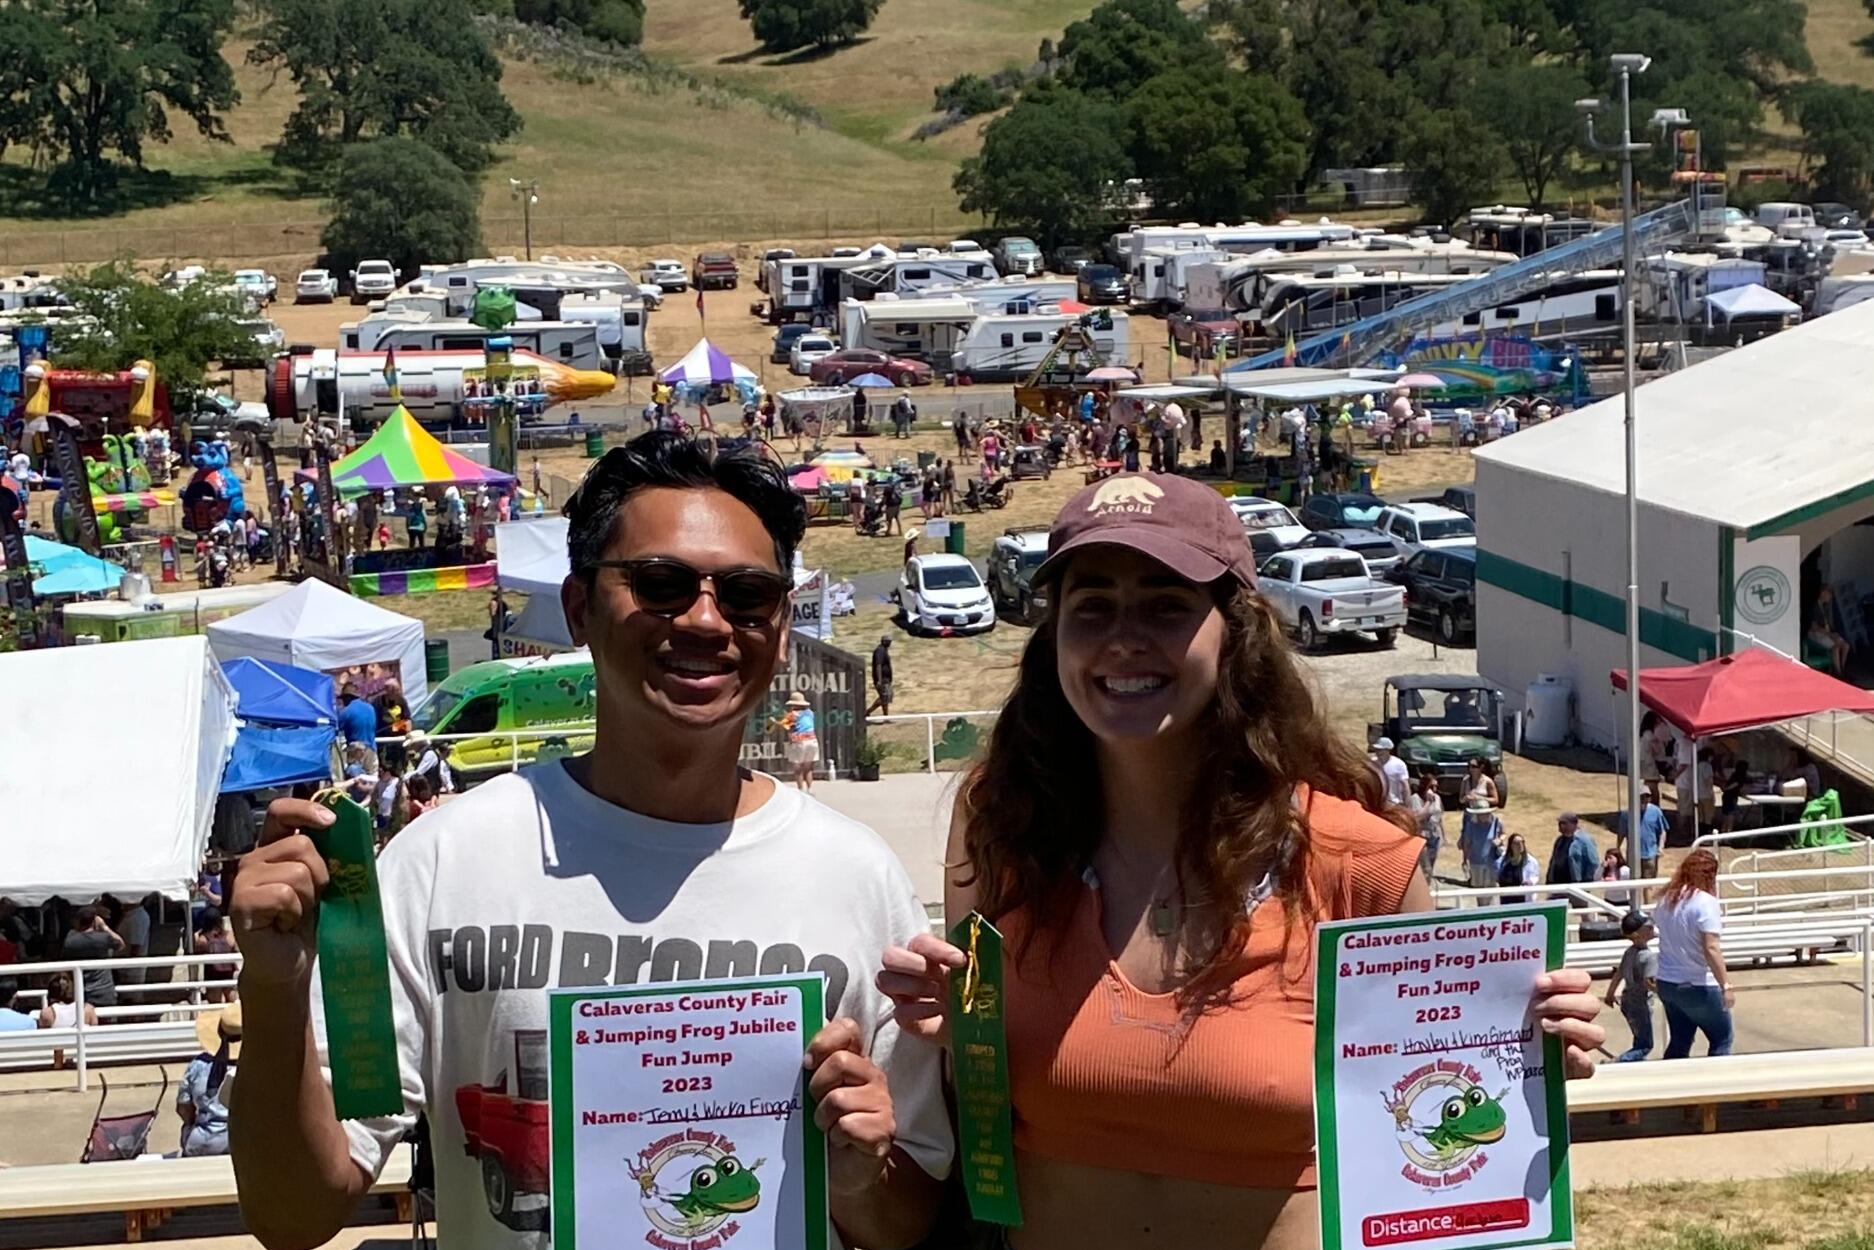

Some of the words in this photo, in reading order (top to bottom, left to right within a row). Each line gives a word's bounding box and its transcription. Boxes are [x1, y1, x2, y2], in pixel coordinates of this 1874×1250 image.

[1344, 930, 1430, 950] Calaveras
[1434, 923, 1497, 943] County
[1501, 919, 1535, 937] Fair
[429, 923, 553, 995] FORD
[1339, 962, 1353, 977] &
[1356, 957, 1431, 978] Jumping
[1434, 952, 1476, 971] Frog
[1479, 947, 1541, 966] Jubilee
[1397, 983, 1431, 998] Fun
[1433, 979, 1481, 997] Jump
[579, 1000, 674, 1018] Calaveras
[679, 994, 746, 1013] County
[751, 991, 788, 1007] Fair
[1416, 1005, 1462, 1023] 2023
[575, 1030, 590, 1045] &
[594, 1026, 677, 1046] Jumping
[681, 1023, 726, 1041] Frog
[729, 1018, 797, 1036] Jubilee
[1342, 1040, 1398, 1059] Name:
[641, 1051, 678, 1068] Fun
[681, 1050, 733, 1069] Jump
[662, 1077, 713, 1094] 2023
[582, 1110, 645, 1126] Name:
